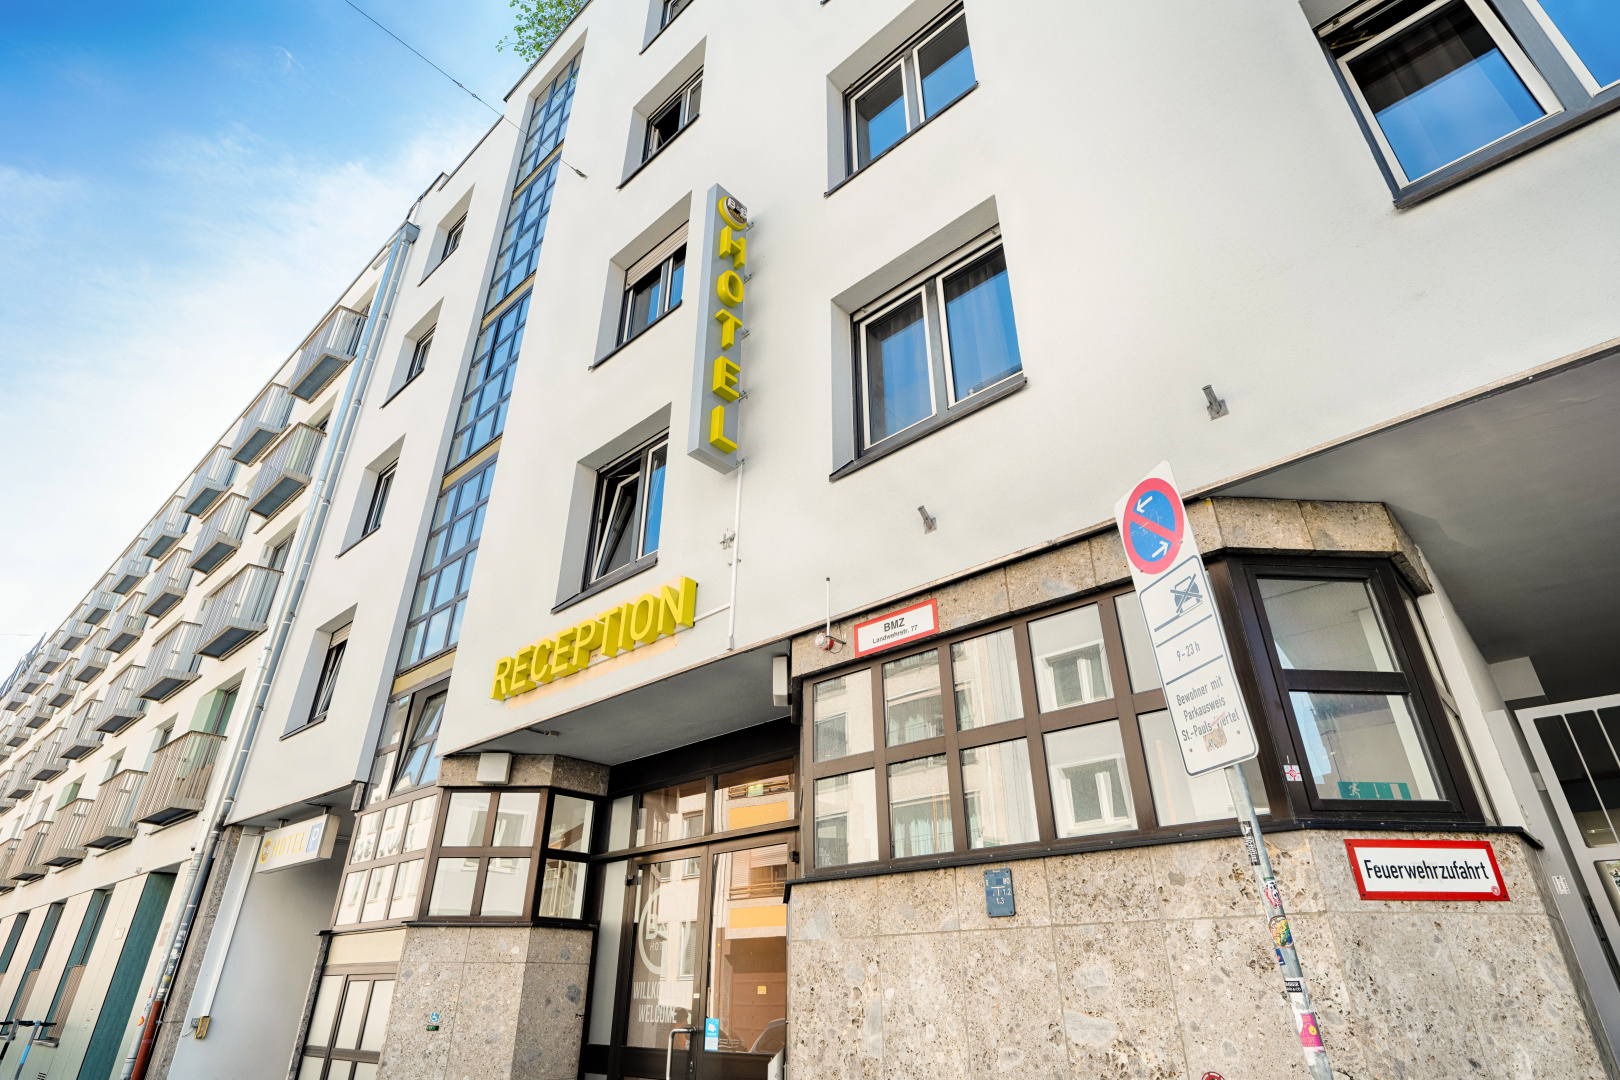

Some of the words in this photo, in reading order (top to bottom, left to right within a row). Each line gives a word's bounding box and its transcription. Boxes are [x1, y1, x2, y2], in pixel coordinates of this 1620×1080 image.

[709, 225, 746, 454] HOTEL
[872, 628, 909, 644] Landwehrstr.
[910, 624, 918, 632] 77
[883, 617, 905, 633] BMZ
[490, 576, 697, 701] RECEPTION
[1176, 684, 1208, 707] Bewohner
[1210, 675, 1224, 691] mit
[1183, 694, 1226, 722] Parkausweis
[271, 832, 305, 858] HOTEL
[1363, 859, 1490, 880] Feuerwehrzufahrt
[638, 1004, 677, 1024] WELCOME
